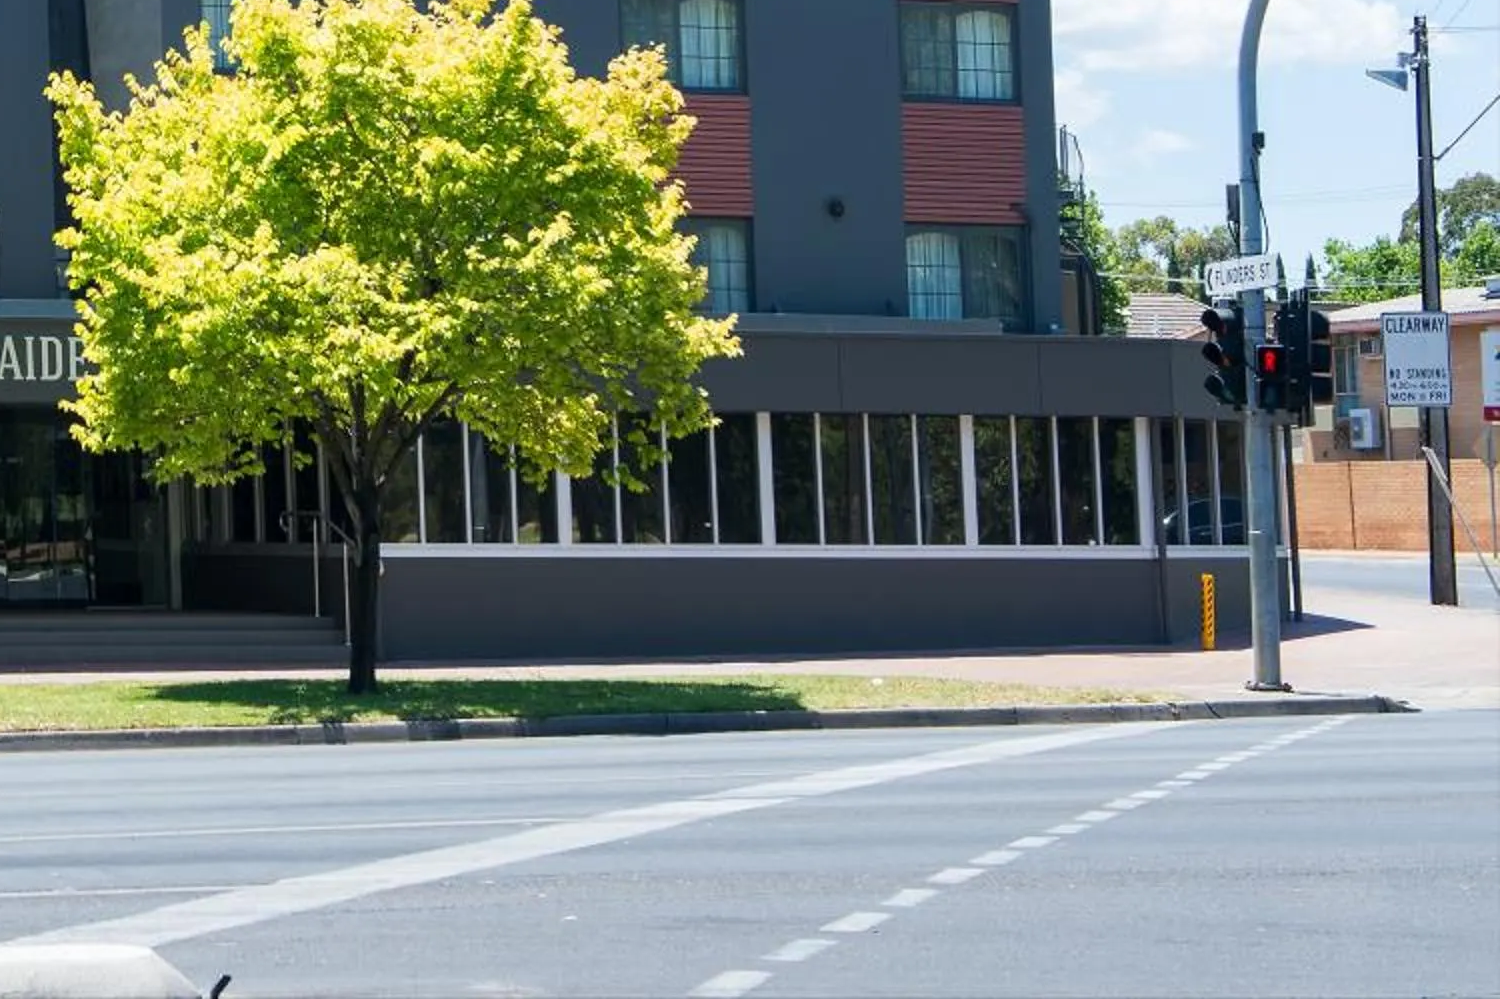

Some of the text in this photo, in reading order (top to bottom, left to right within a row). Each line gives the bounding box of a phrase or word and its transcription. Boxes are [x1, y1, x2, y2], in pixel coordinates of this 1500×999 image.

[1215, 262, 1270, 286] FLINDERS ST
[1385, 316, 1445, 334] CLEARWAY
[1389, 367, 1447, 379] NO STANDING
[1391, 392, 1416, 401] MON
